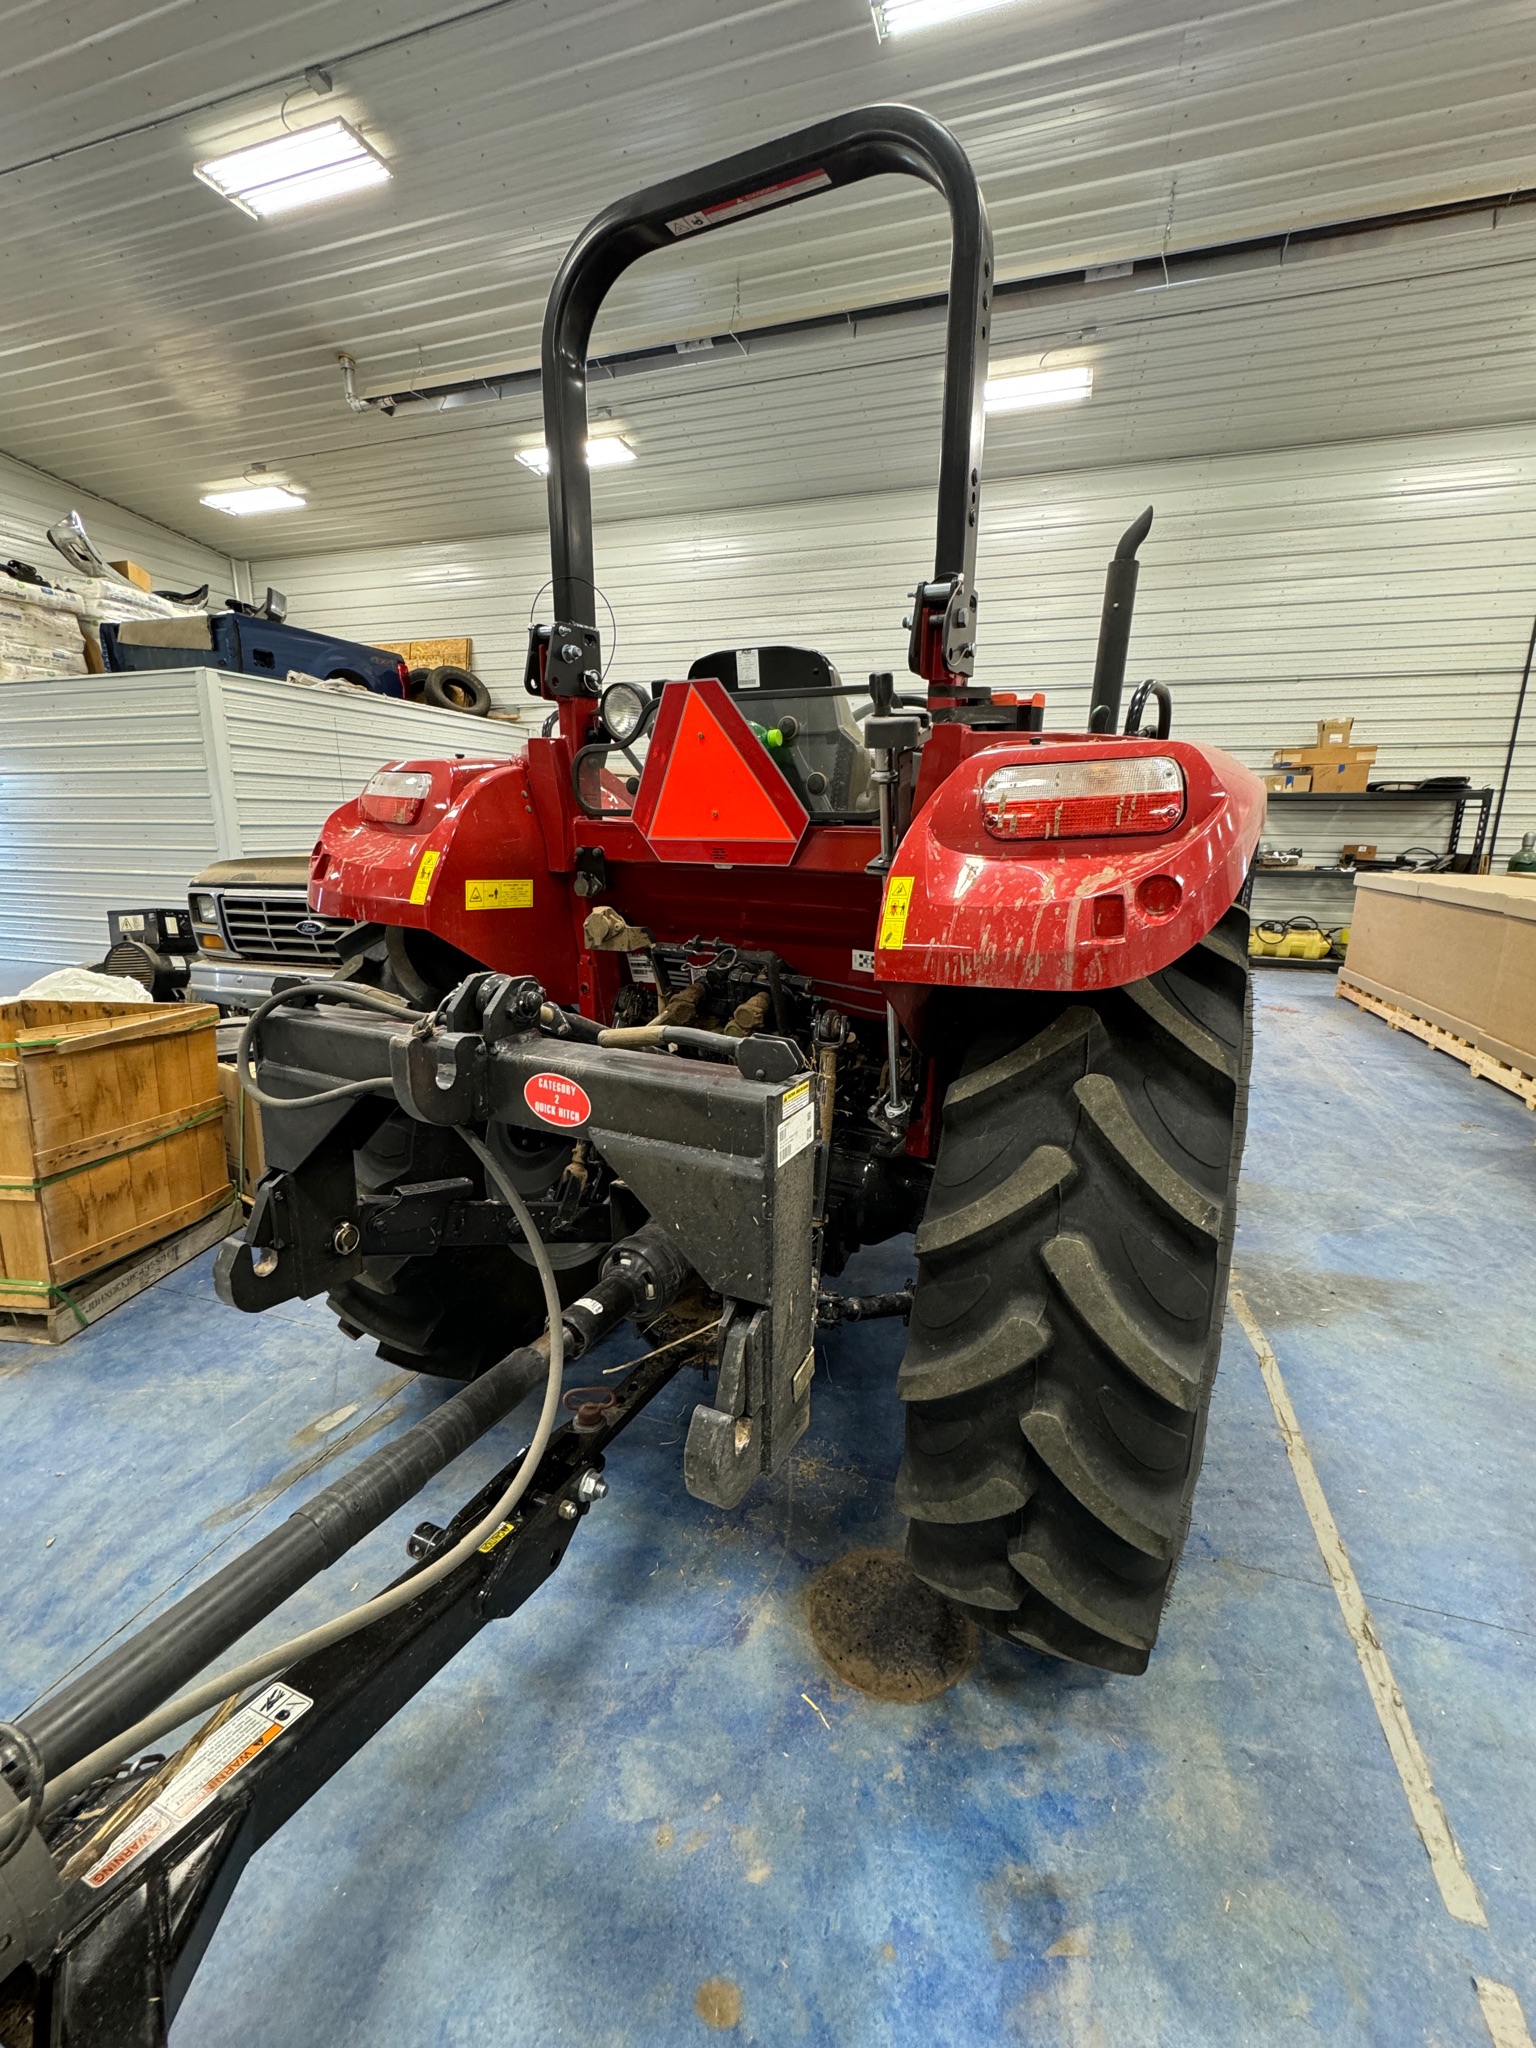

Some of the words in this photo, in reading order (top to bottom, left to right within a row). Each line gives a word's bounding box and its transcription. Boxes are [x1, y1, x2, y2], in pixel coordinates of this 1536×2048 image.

[538, 1077, 577, 1096] CATEGORY
[554, 1094, 560, 1105] 2
[534, 1101, 556, 1115] QUICK
[558, 1107, 580, 1122] HITCH
[197, 1751, 252, 1802] WARNIN
[93, 1832, 149, 1883] WARNING
